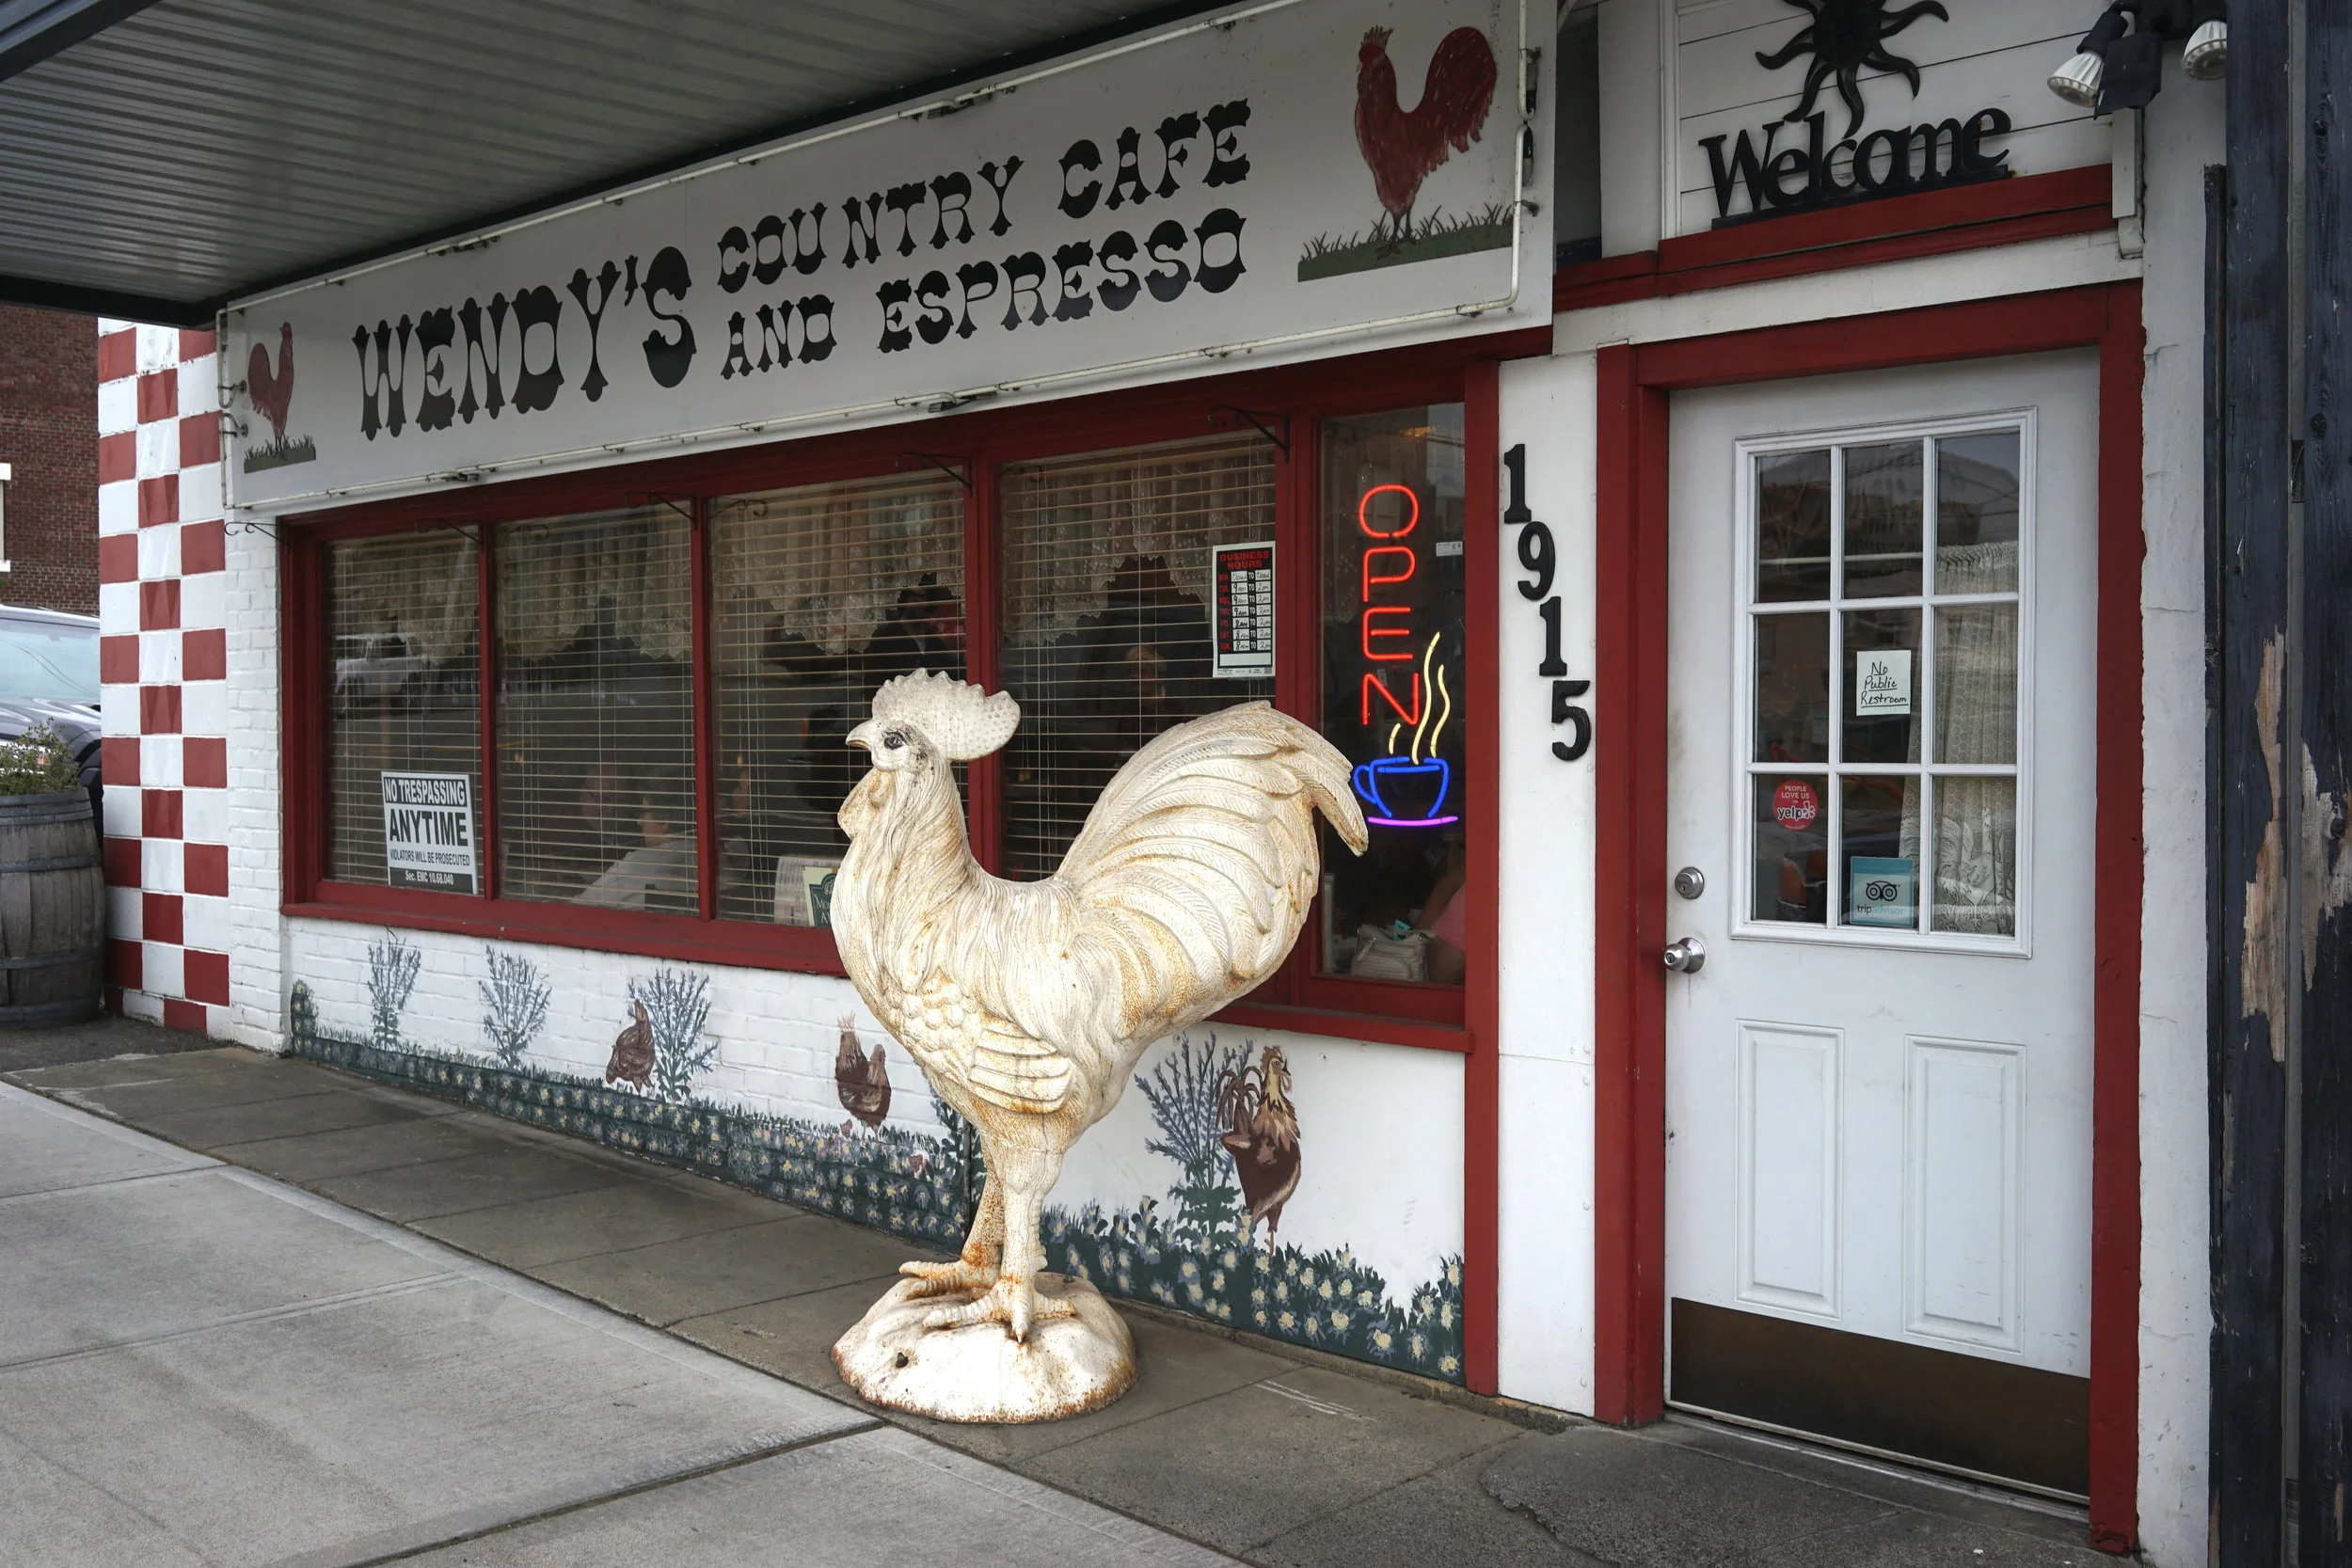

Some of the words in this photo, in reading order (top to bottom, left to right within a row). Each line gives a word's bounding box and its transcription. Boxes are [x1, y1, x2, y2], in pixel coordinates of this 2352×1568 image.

[1697, 107, 2011, 218] Welcome
[717, 155, 1025, 294] COUNTRY
[1057, 97, 1252, 219] CAFE
[720, 293, 838, 380] AND
[876, 207, 1248, 354] ESPRESSO
[351, 245, 697, 441] WENDY'S
[1219, 550, 1269, 561] BUSINESS
[1227, 560, 1262, 569] HOURS
[1248, 583, 1255, 592] TO
[1248, 594, 1255, 603] TO
[1358, 483, 1420, 727] OPEN
[1502, 442, 1592, 763] 1915
[1249, 607, 1255, 615] TO
[1250, 629, 1256, 638] TO
[1871, 661, 1888, 675] No
[1864, 675, 1898, 690] Public
[1861, 690, 1907, 705] Restroom
[385, 778, 398, 802] NO
[399, 779, 466, 806] TRESPASSING
[1777, 805, 1803, 821] yelp
[389, 808, 469, 847] ANYTIME
[389, 848, 415, 863] VIOLATORS
[415, 850, 427, 863] WILL
[427, 852, 436, 864] BE
[435, 852, 470, 866] PROSECUTED
[405, 870, 416, 881] Sec.
[1857, 904, 1904, 915] tripadvisor
